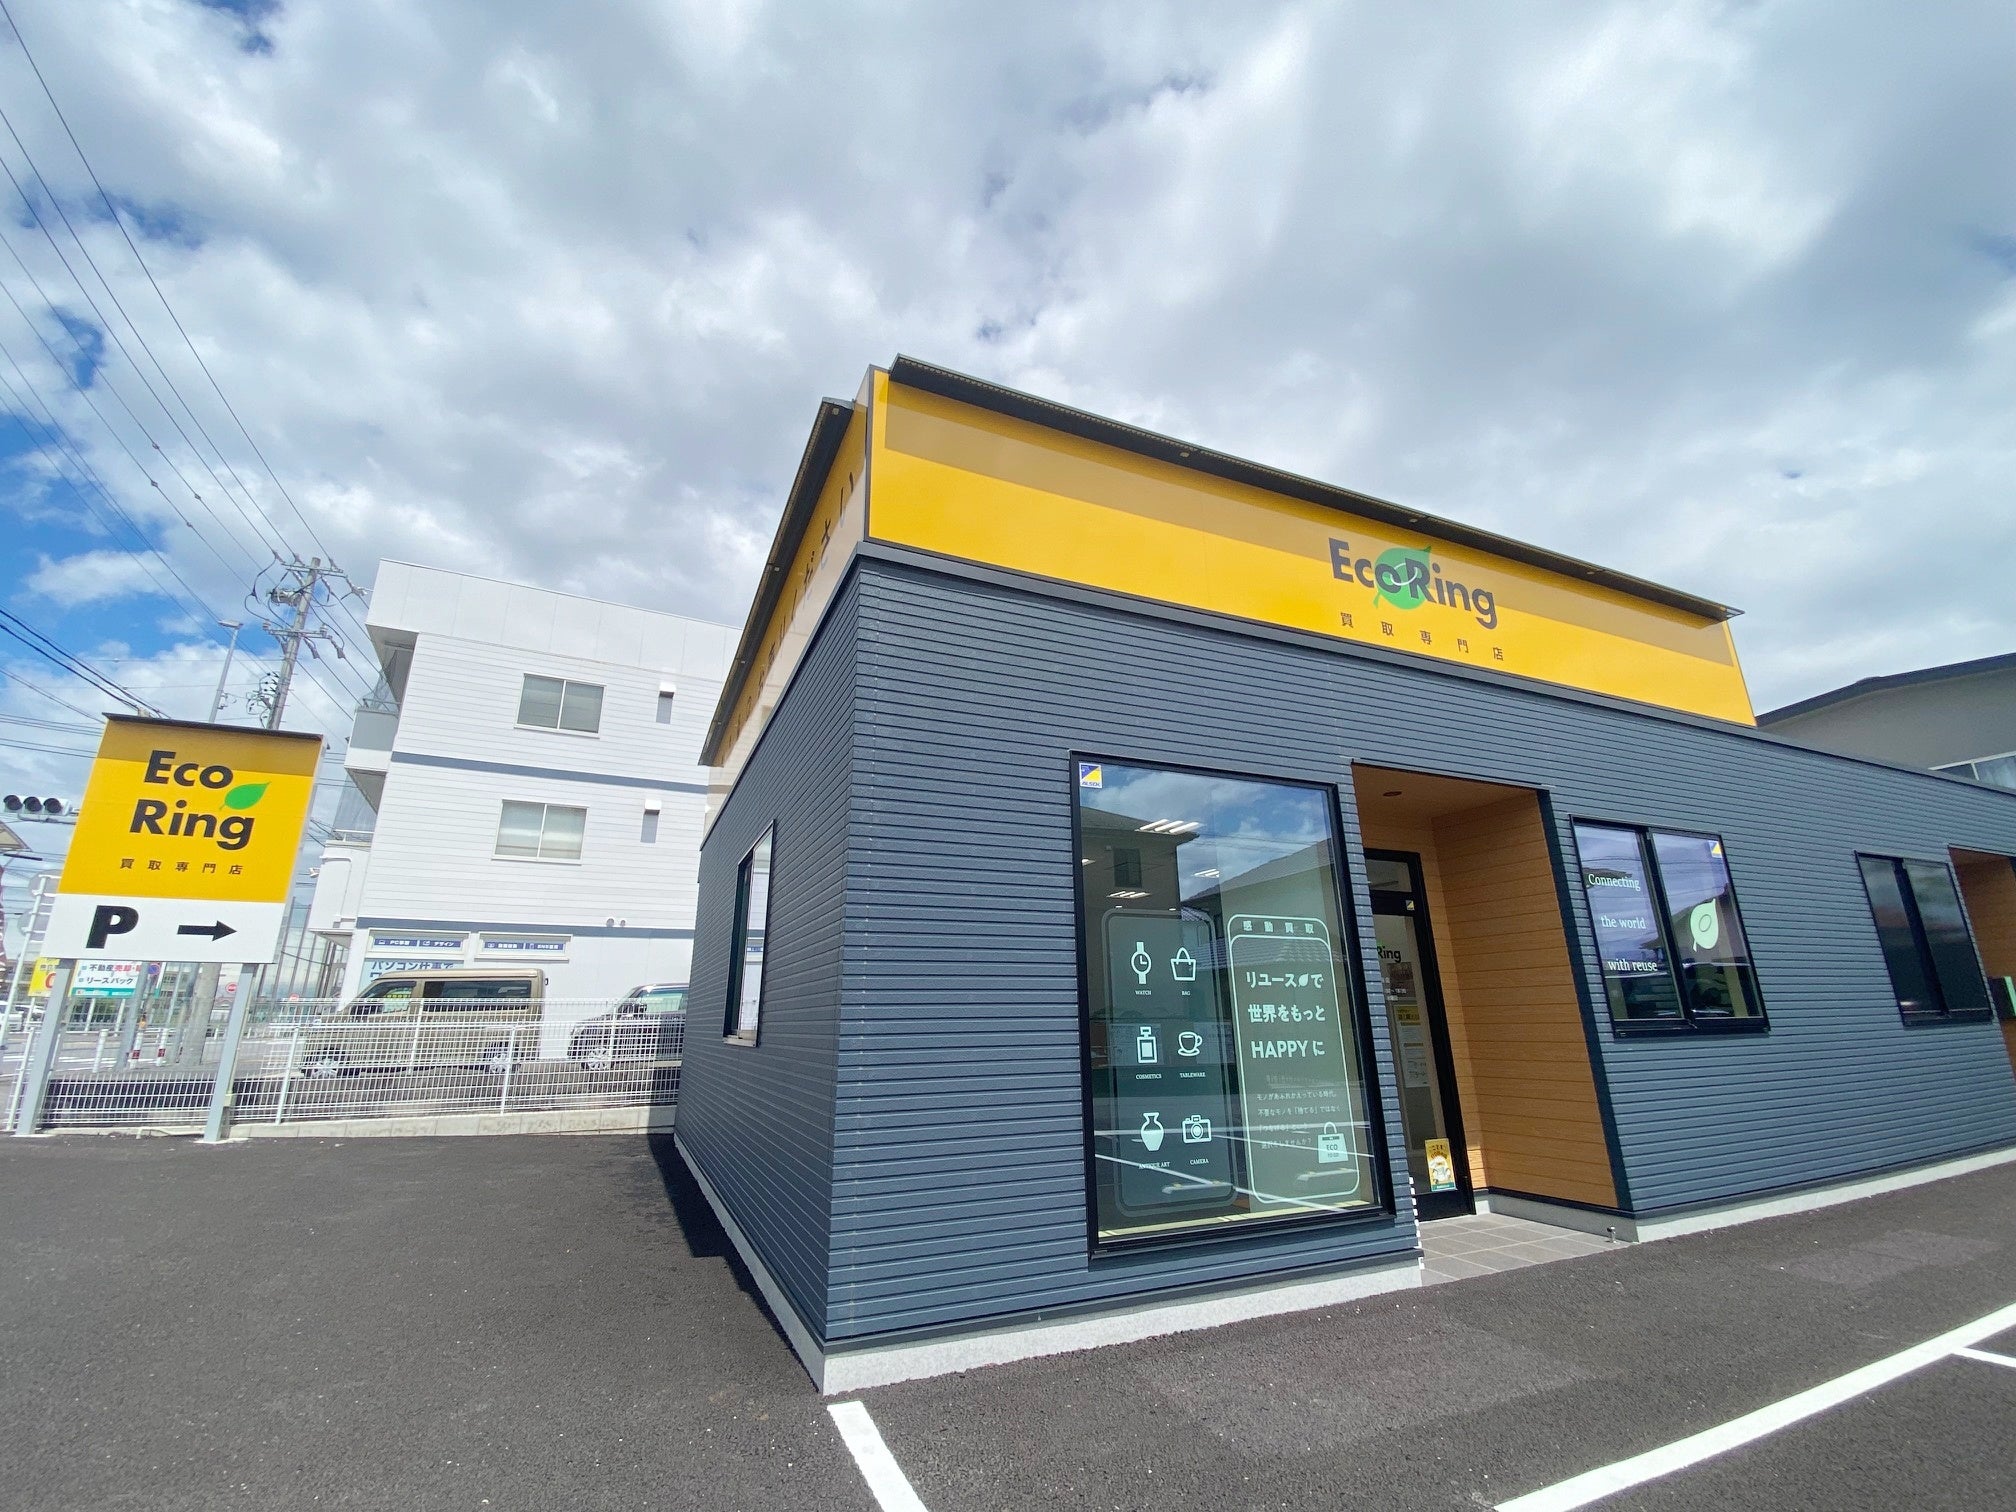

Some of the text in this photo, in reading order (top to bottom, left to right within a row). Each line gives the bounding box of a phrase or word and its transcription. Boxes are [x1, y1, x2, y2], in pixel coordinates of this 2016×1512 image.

[1328, 537, 1498, 630] EcoRing
[1340, 612, 1504, 662] 買取専門店
[144, 750, 233, 789] Eco
[129, 799, 255, 851] Ring
[120, 858, 244, 876] 買取専門店
[1588, 874, 1641, 891] Connecting
[86, 905, 139, 949] P
[1601, 914, 1646, 929] the world
[1608, 959, 1658, 971] with reuse
[87, 977, 133, 985] リースバック
[1246, 972, 1324, 989] リユース で
[1248, 1004, 1326, 1023] 世界をもっと
[1251, 1040, 1308, 1058] HAPPY
[1312, 1040, 1325, 1056] に
